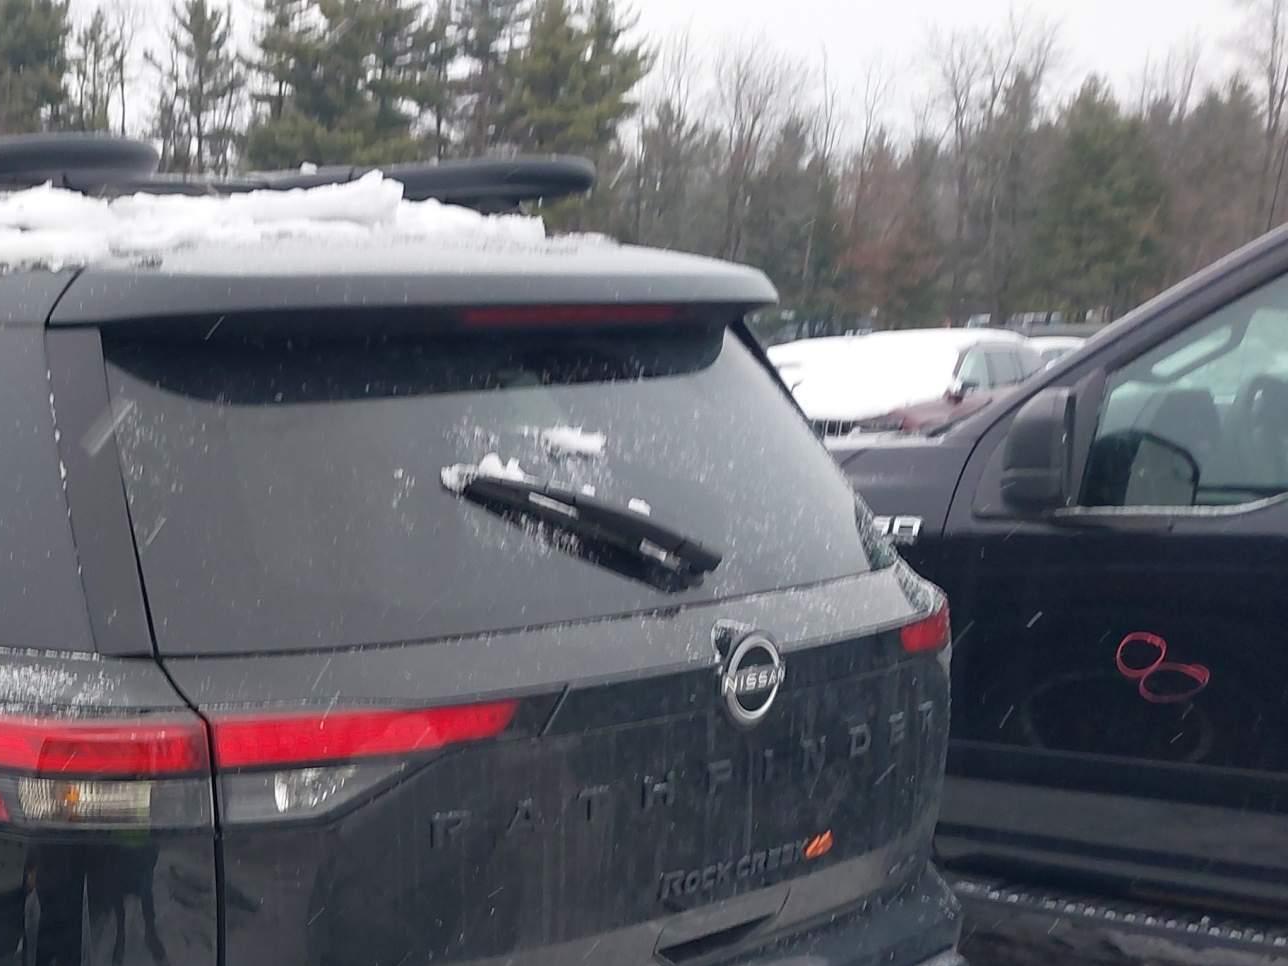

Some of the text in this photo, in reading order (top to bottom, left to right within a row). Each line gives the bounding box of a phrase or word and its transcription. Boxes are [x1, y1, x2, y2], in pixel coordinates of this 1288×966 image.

[722, 661, 786, 696] NISSAN
[429, 701, 934, 849] PATHFINDER
[657, 837, 809, 900] ROCK CREEK
